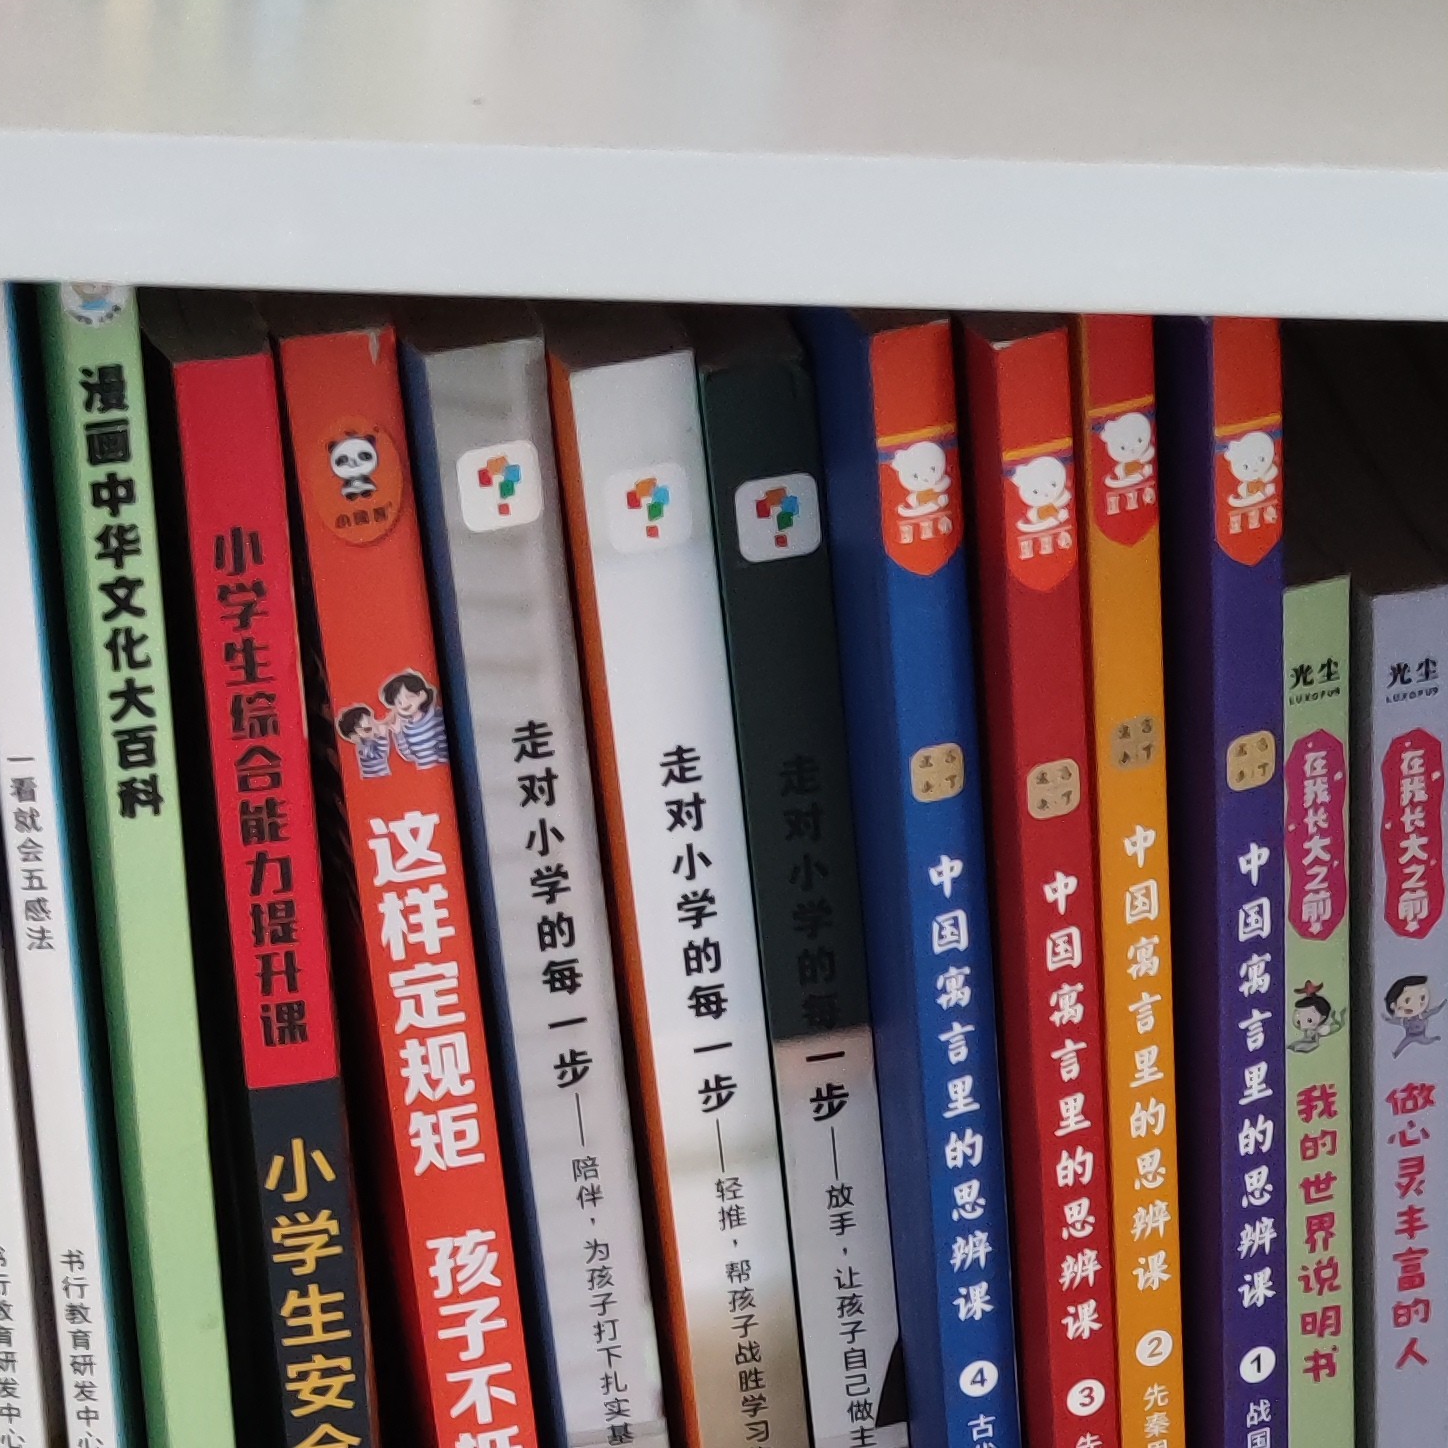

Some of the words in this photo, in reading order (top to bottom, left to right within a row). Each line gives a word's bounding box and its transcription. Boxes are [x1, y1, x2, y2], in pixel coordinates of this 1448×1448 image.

[78, 362, 165, 820] 漫画中华文化大百科
[1290, 657, 1341, 689] 光尘
[1388, 656, 1440, 688] 光尘
[6, 755, 55, 953] 一看就会五感法
[213, 524, 310, 1051] 小学生综合能力提升课
[1300, 749, 1334, 924] 在我长大之前
[1398, 747, 1430, 922] 在我长大之前
[366, 809, 487, 1178] 这样定规矩
[928, 853, 996, 1322] 中国寓言里的思辨课
[1041, 870, 1104, 1342] 中国寓言里的思辨课
[1122, 823, 1174, 1294] 中国寓言里的思辨课
[1236, 841, 1278, 1310] 中国寓言里的思辨课
[1296, 1081, 1343, 1385] 我的世界说明书
[1383, 1081, 1438, 1372] 做心灵丰富的人
